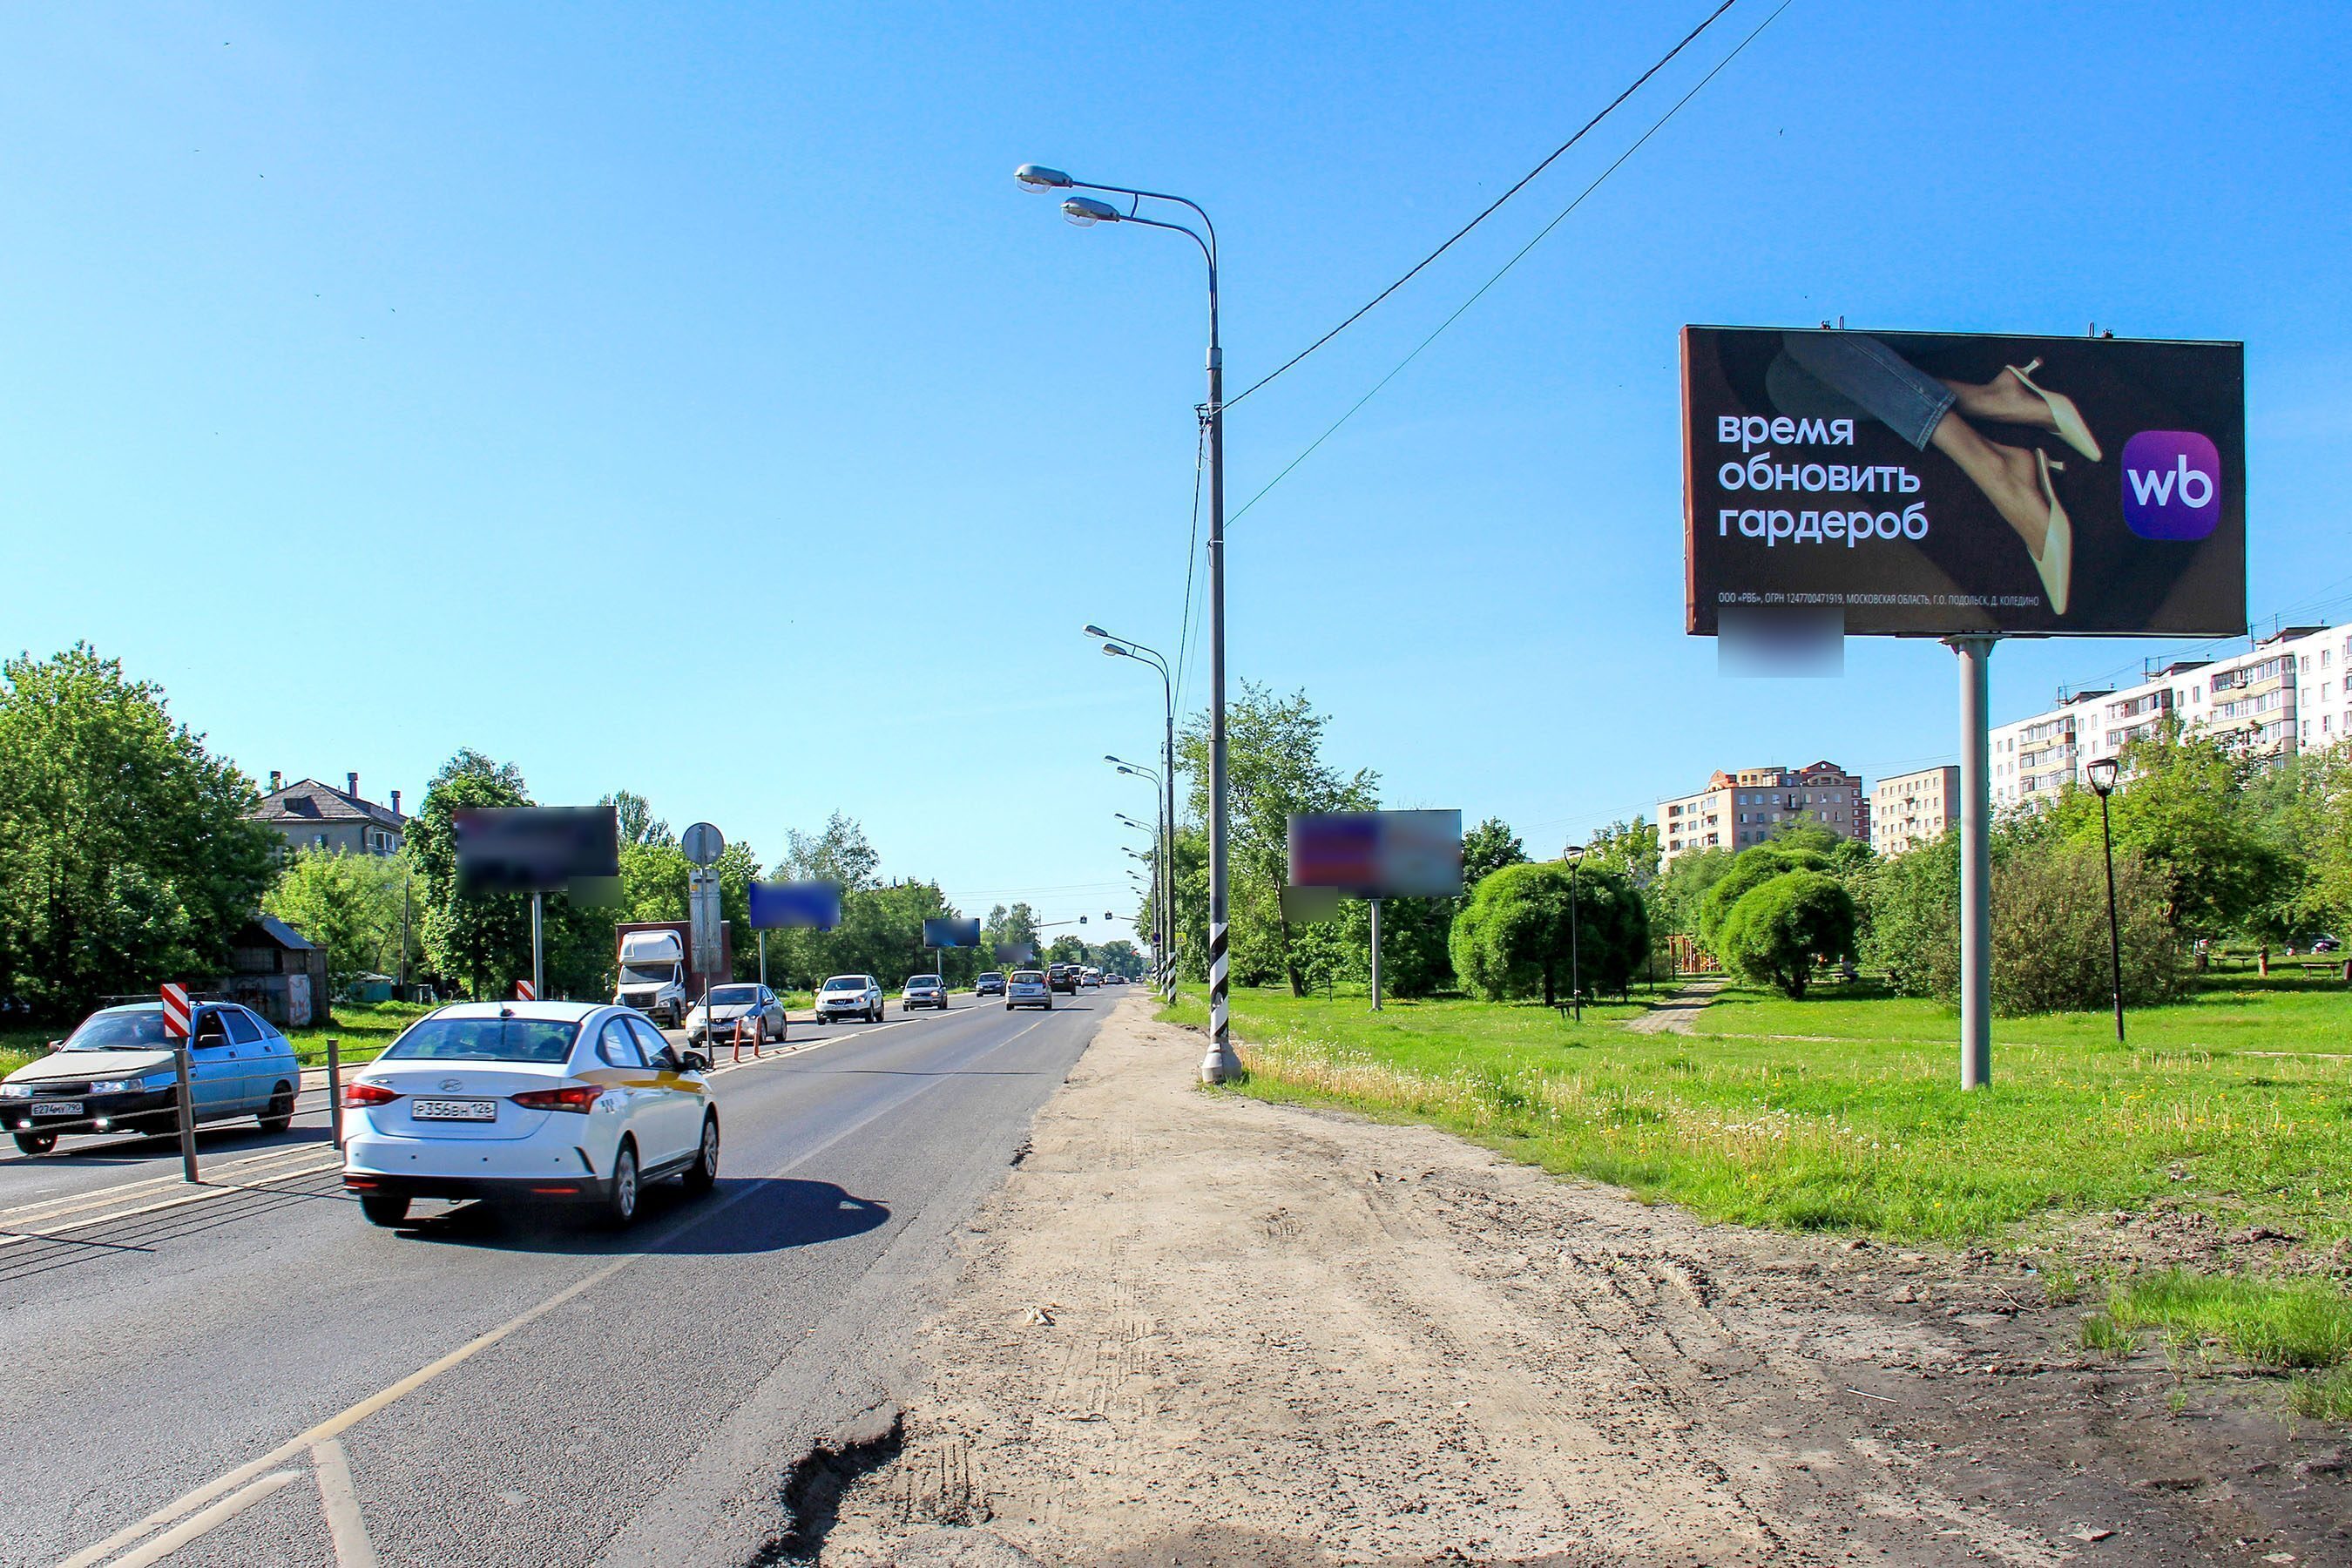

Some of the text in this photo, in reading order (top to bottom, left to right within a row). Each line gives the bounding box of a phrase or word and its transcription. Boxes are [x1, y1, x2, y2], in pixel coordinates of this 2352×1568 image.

[1719, 416, 1854, 452] время
[1719, 452, 1921, 494] обновить
[2126, 454, 2213, 509] wb
[1719, 501, 1930, 548] гардероб
[1718, 592, 1736, 603] ООО
[1765, 593, 1785, 603] ОГРН
[1847, 594, 1896, 605] МОСКОВСКАЯ
[1897, 594, 1931, 605] ОБЛАСТЬ,
[1933, 595, 1947, 605] Г.О.
[1949, 596, 1989, 606] ПОДОЛЬСК,
[2000, 596, 2039, 606] КОЛЕДИНО
